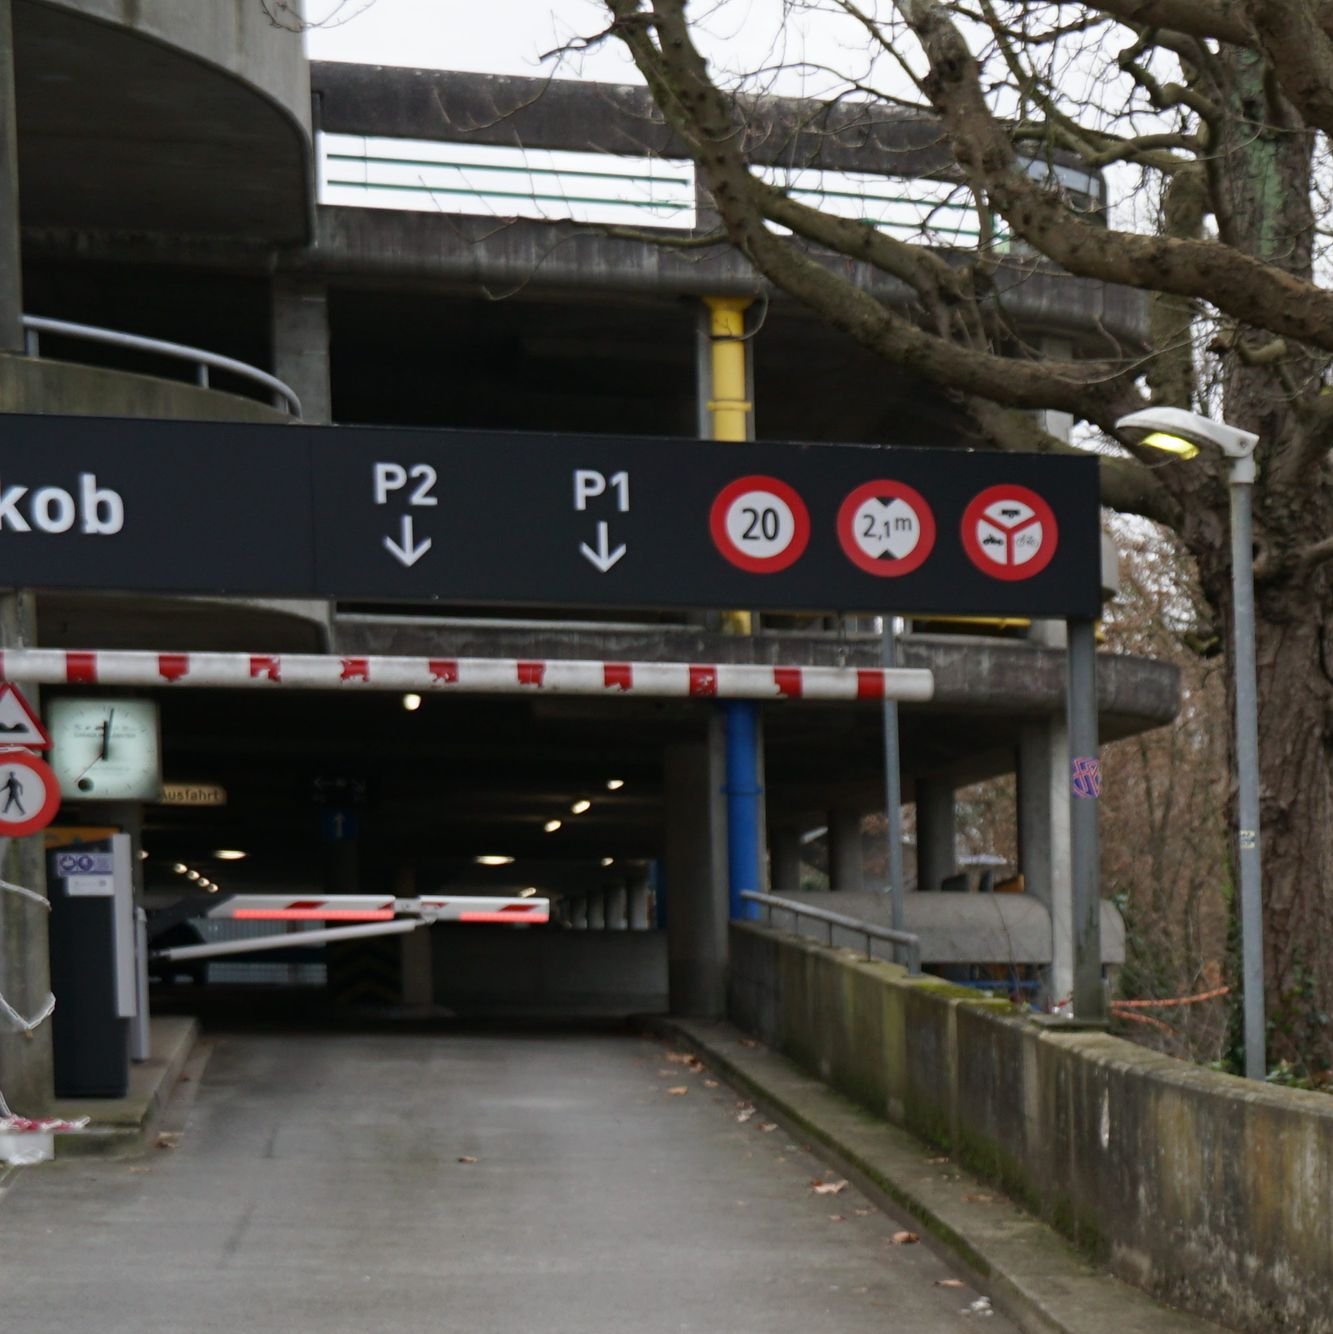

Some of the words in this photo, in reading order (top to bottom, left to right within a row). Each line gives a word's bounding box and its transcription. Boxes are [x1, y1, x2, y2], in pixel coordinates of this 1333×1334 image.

[373, 462, 438, 506] P2
[573, 469, 629, 512] P1
[741, 507, 780, 541] 20
